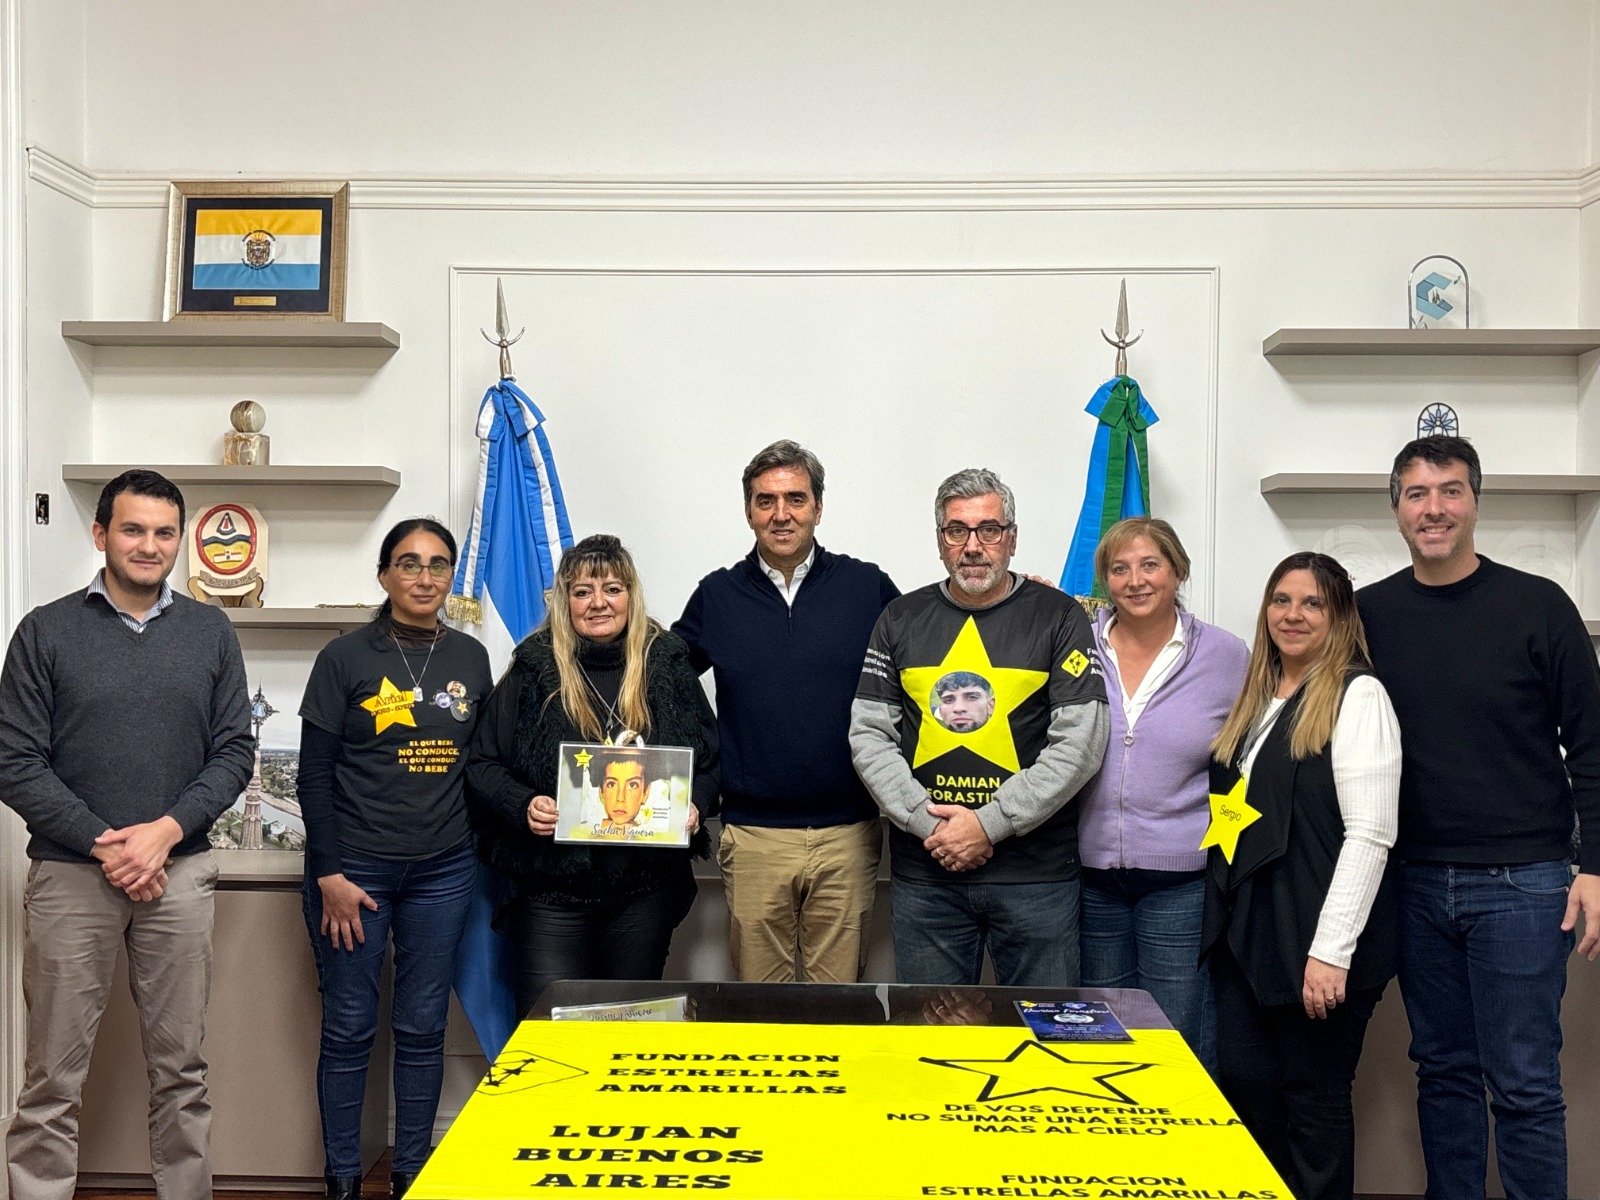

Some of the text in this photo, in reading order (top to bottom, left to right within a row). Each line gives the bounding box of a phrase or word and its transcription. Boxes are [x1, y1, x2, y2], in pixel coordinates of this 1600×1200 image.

[936, 774, 1000, 789] DAMIAN
[1219, 804, 1242, 822] Sergio
[611, 1053, 841, 1063] FUNDACION
[607, 1068, 841, 1078] ESTRELLAS
[595, 1083, 848, 1095] AMARILLAS
[944, 1103, 1172, 1116] DE VOS DEPENDE
[886, 1113, 1244, 1127] NO SUMAR UNA ESTRELLA
[549, 1125, 742, 1142] LUJAN
[973, 1124, 1168, 1136] MAS AL CIELO
[512, 1147, 765, 1164] BUENOS
[530, 1172, 732, 1190] AIRES
[1000, 1174, 1187, 1187] FUNDACION
[921, 1185, 1279, 1200] ESTRELLAS AMARILLAS
